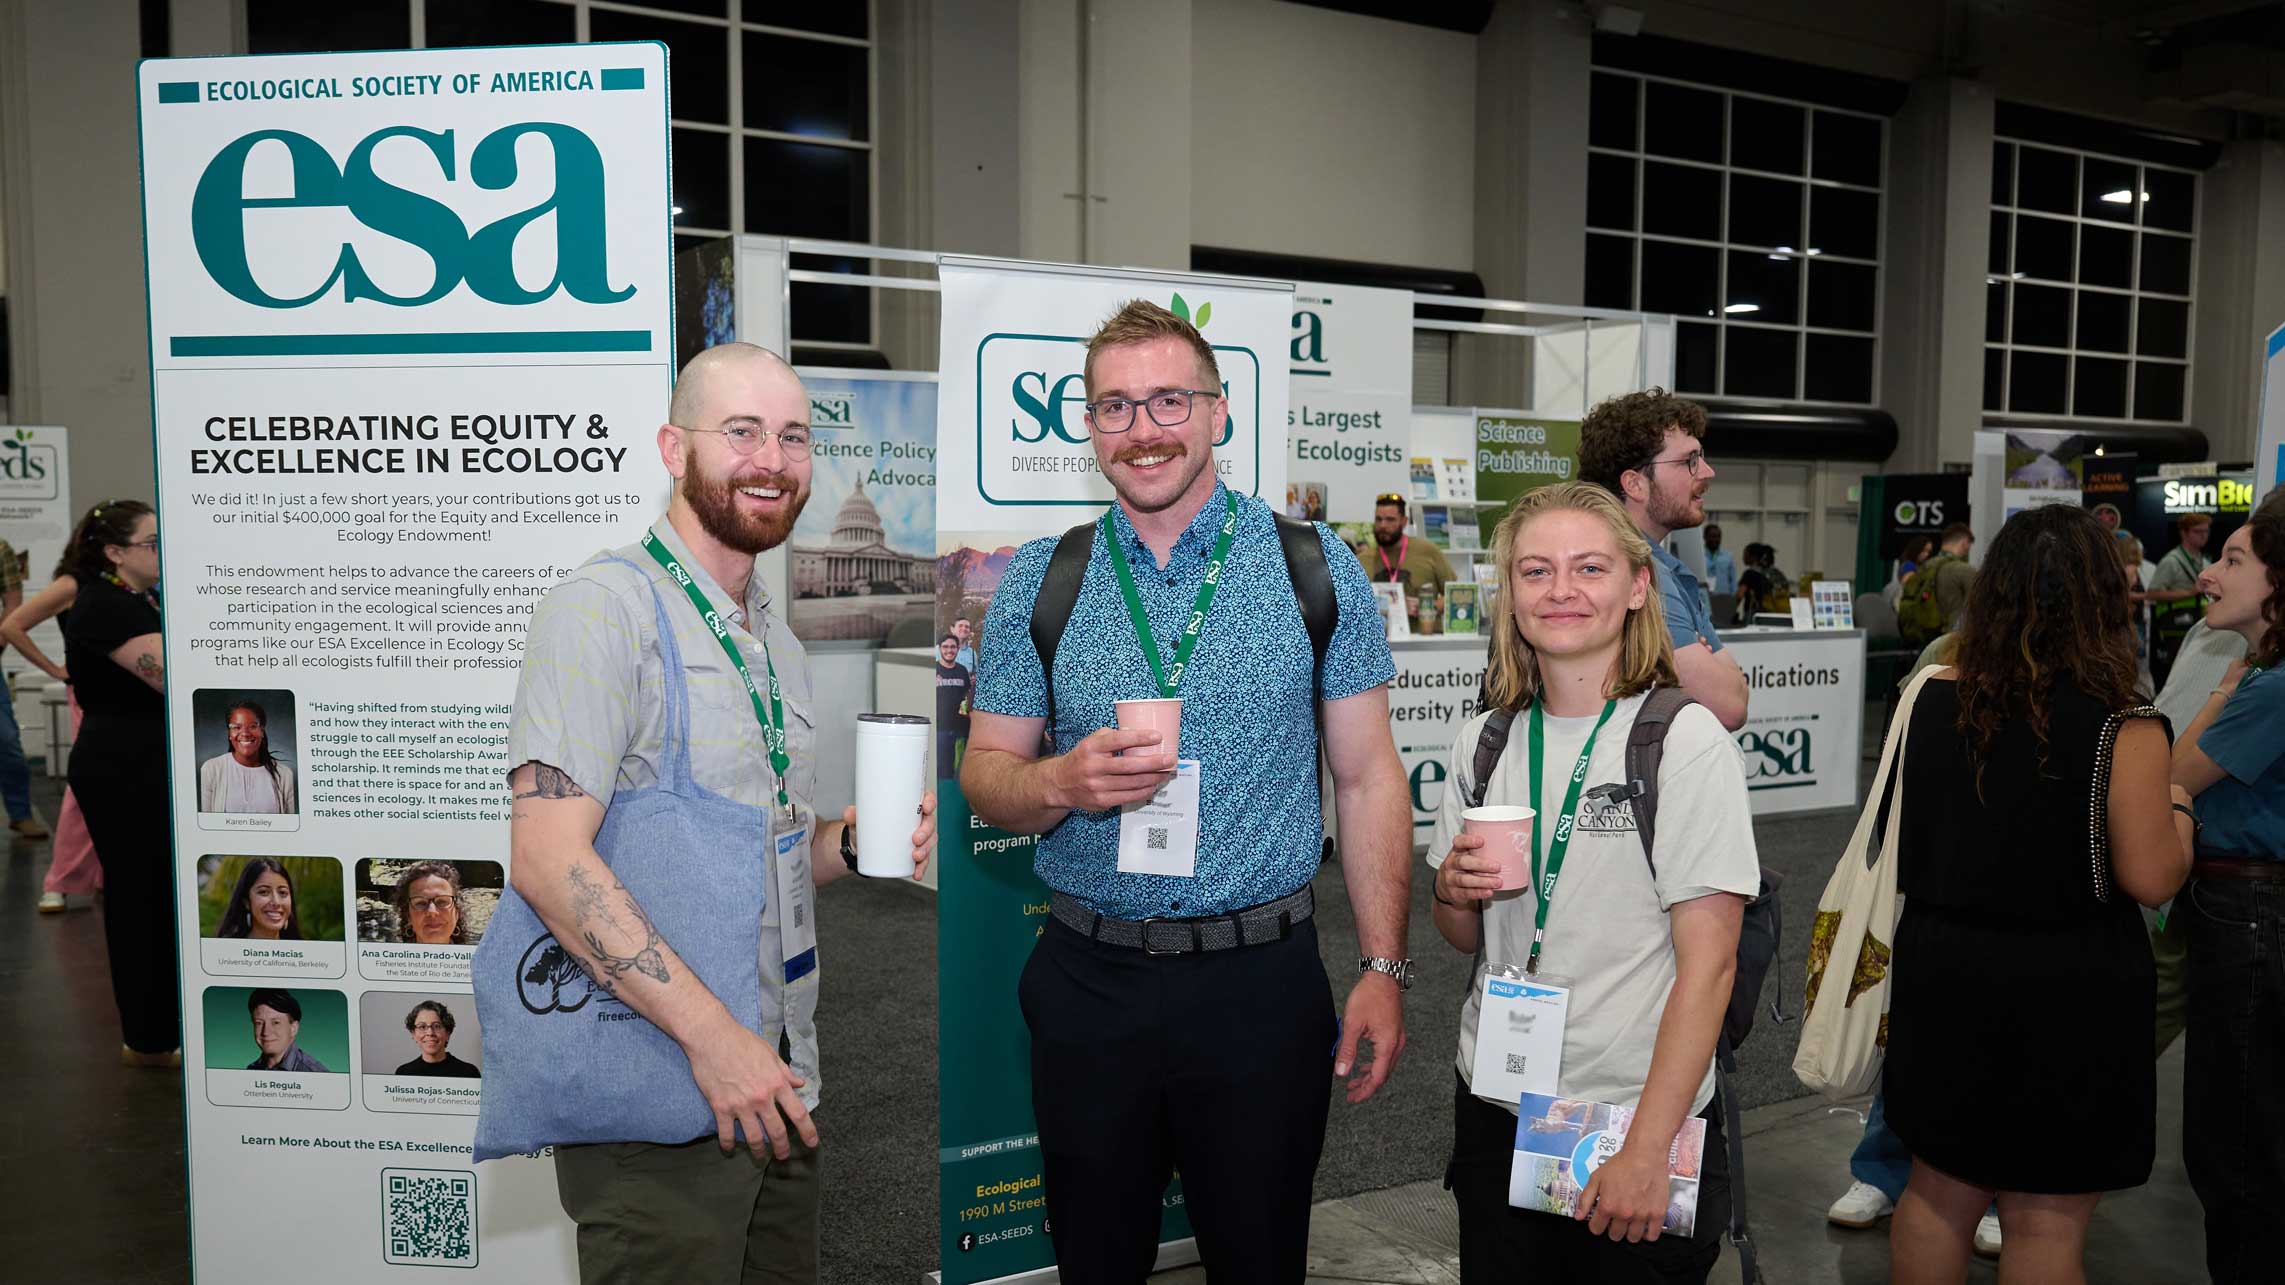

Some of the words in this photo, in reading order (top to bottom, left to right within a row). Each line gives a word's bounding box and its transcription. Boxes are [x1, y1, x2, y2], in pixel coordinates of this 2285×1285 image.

[207, 77, 344, 102] ECOLOGICAL
[351, 74, 443, 98] SOCIETY
[452, 73, 481, 95] OF
[490, 70, 595, 94] AMERICA
[192, 122, 638, 308] esa
[1302, 405, 1382, 433] Largest
[204, 414, 439, 443] CELEBRATING
[450, 414, 577, 446] EQUITY
[586, 413, 610, 440] &
[1479, 420, 1546, 445] Science
[191, 448, 406, 475] EXCELLENCE
[416, 447, 450, 474] IN
[461, 447, 628, 474] ECOLOGY
[880, 441, 937, 464] Policy
[1297, 439, 1403, 467] Ecologists
[1012, 455, 1060, 473] DIVERSE
[1478, 450, 1570, 478] Publishing
[191, 493, 216, 506] We
[218, 492, 242, 506] did
[245, 492, 259, 506] it!
[262, 493, 277, 506] In
[278, 492, 307, 509] just
[309, 495, 318, 506] a
[321, 492, 348, 506] few
[351, 492, 389, 506] short
[391, 495, 434, 509] years,
[435, 495, 470, 509] your
[472, 491, 572, 506] contributions
[574, 493, 601, 509] got
[604, 495, 622, 506] us
[624, 493, 641, 506] to
[212, 513, 237, 524] our
[240, 510, 279, 524] initial
[282, 509, 351, 526] $400,000
[354, 510, 386, 527] goal
[389, 510, 409, 524] for
[411, 510, 437, 524] the
[440, 510, 488, 527] Equity
[490, 510, 519, 524] and
[523, 510, 602, 524] Excellence
[605, 510, 619, 524] in
[1894, 500, 1945, 526] OTS
[337, 529, 395, 545] Ecology
[397, 528, 492, 542] Endowment!
[205, 564, 236, 578] This
[237, 564, 326, 578] endowment
[329, 564, 369, 581] helps
[370, 566, 387, 579] to
[389, 565, 451, 579] advance
[453, 565, 479, 579] the
[481, 568, 536, 579] careers
[538, 565, 554, 579] of
[195, 582, 243, 596] whose
[245, 583, 307, 596] research
[310, 583, 338, 596] and
[341, 583, 392, 597] service
[394, 583, 491, 600] meaningfully
[227, 600, 318, 617] participation
[321, 600, 334, 614] in
[337, 601, 363, 614] the
[365, 601, 438, 618] ecological
[441, 601, 504, 615] sciences
[506, 601, 535, 615] and
[705, 610, 727, 640] esa
[309, 701, 355, 715] “Having
[357, 702, 398, 714] shifted
[399, 702, 428, 714] from
[430, 703, 482, 717] studying
[309, 717, 332, 728] and
[334, 717, 360, 728] how
[361, 717, 389, 731] they
[390, 717, 437, 729] interact
[438, 718, 465, 730] with
[467, 719, 488, 730] the
[309, 732, 359, 745] struggle
[360, 733, 374, 744] to
[375, 733, 396, 744] call
[398, 733, 438, 746] myself
[439, 736, 454, 745] an
[456, 734, 510, 748] ecologist
[1738, 728, 1815, 780] esa
[1573, 754, 1589, 784] esa
[225, 817, 249, 826] Karen
[249, 817, 273, 828] Bailey
[1556, 813, 1574, 843] esa
[1578, 815, 1635, 829] CANYON
[973, 835, 1031, 856] program
[242, 948, 270, 958] Diana
[271, 949, 304, 959] Macias
[361, 949, 381, 959] Ana
[381, 950, 422, 960] Carolina
[423, 951, 474, 961] Prado-Vall
[217, 958, 254, 968] University
[298, 960, 329, 970] Berkeley
[375, 959, 407, 968] Fisheries
[407, 961, 439, 969] Institute
[243, 1089, 278, 1098] Otterbein
[278, 1090, 314, 1101] University
[254, 1079, 269, 1089] Lis
[269, 1081, 302, 1092] Regula
[383, 1084, 416, 1095] Julissa
[392, 1095, 427, 1105] University
[437, 1097, 481, 1106] Connecticut
[241, 1134, 277, 1146] Learn
[279, 1136, 311, 1148] More
[313, 1137, 352, 1150] About
[353, 1139, 376, 1151] the
[378, 1140, 404, 1152] ESA
[406, 1141, 474, 1155] Excellence
[961, 1142, 1004, 1158] SUPPORT
[1005, 1138, 1024, 1150] THE
[976, 1174, 1042, 1198] Ecological
[959, 1205, 990, 1223] 1990
[992, 1201, 1006, 1216] M
[1008, 1195, 1047, 1213] Street
[977, 1224, 1034, 1245] ESA-SEEDS
